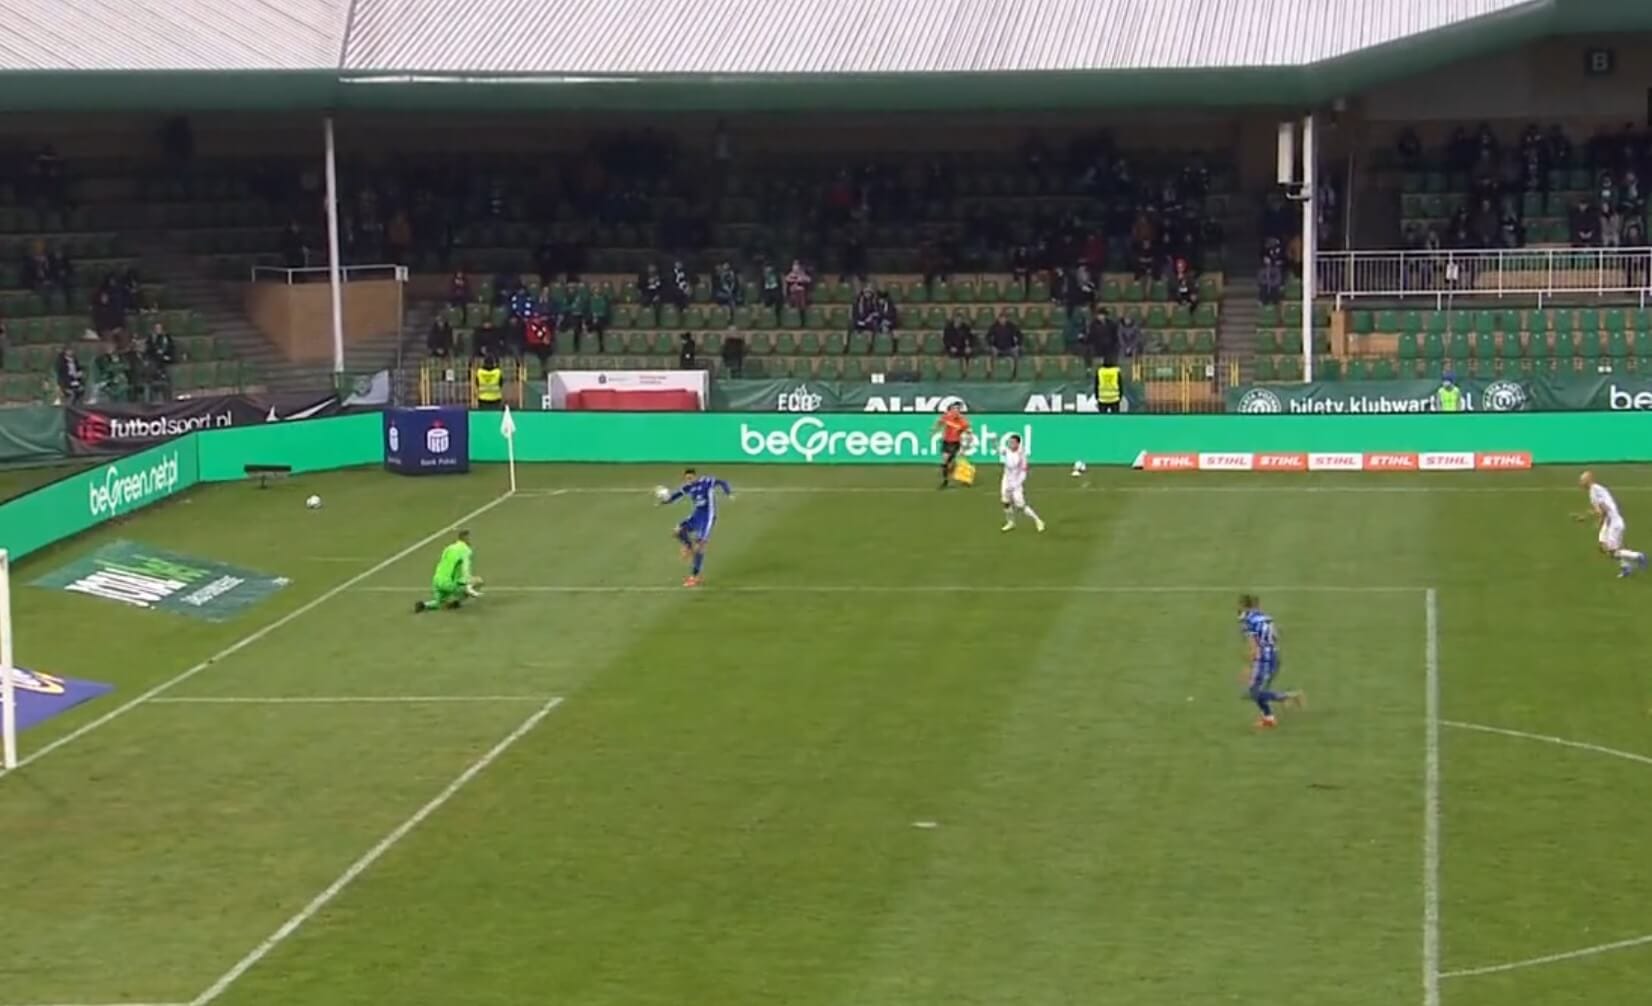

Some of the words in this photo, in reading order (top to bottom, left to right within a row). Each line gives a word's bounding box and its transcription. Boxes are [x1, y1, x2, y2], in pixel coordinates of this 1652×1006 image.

[1592, 52, 1608, 71] B
[110, 410, 232, 438] futbolsportpl
[1151, 456, 1193, 466] STIHL
[1207, 456, 1247, 466] STIHL
[1259, 455, 1301, 466] STIHL
[1315, 455, 1356, 465] STIHL
[1369, 455, 1412, 466] STIHL
[1425, 455, 1468, 465] STIHL
[1482, 454, 1524, 466] STIHL
